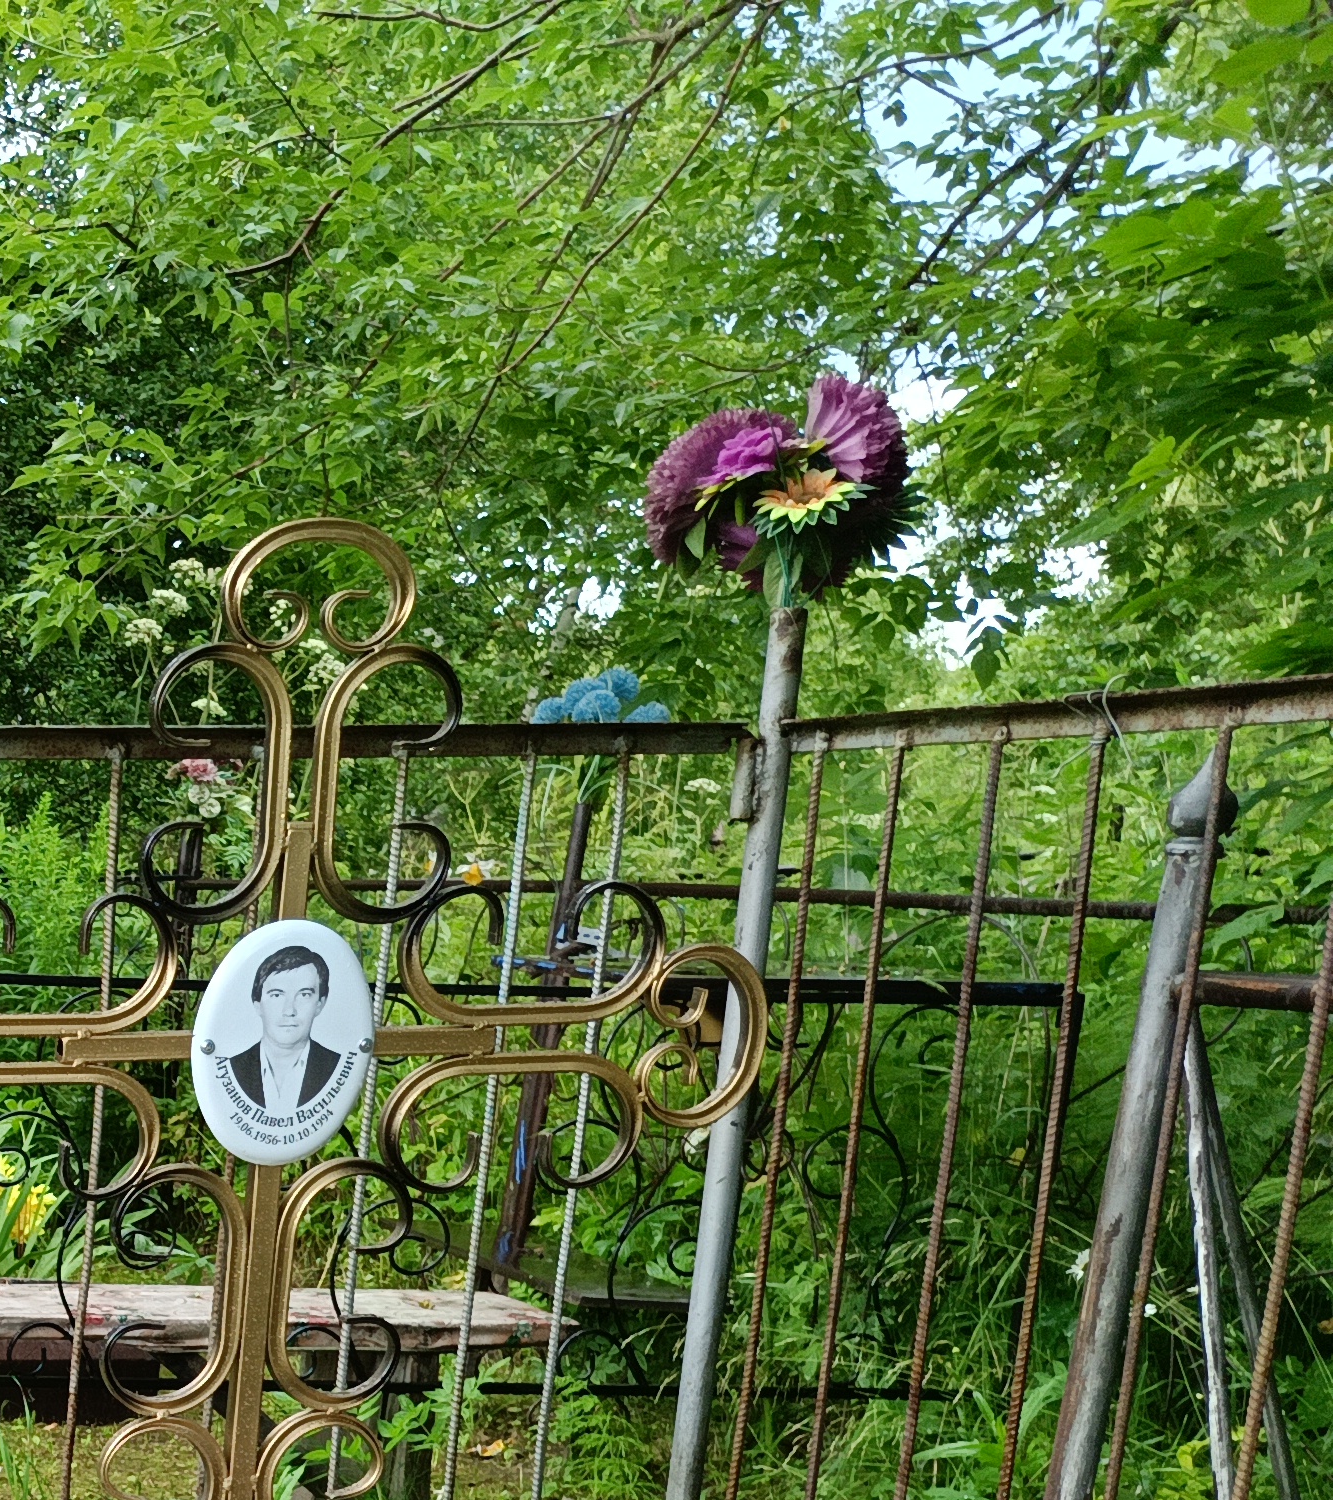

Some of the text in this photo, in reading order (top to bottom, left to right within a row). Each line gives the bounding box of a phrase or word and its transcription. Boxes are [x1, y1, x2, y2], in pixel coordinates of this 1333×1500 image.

[215, 1051, 358, 1128] Агузанов Павел Васильевич
